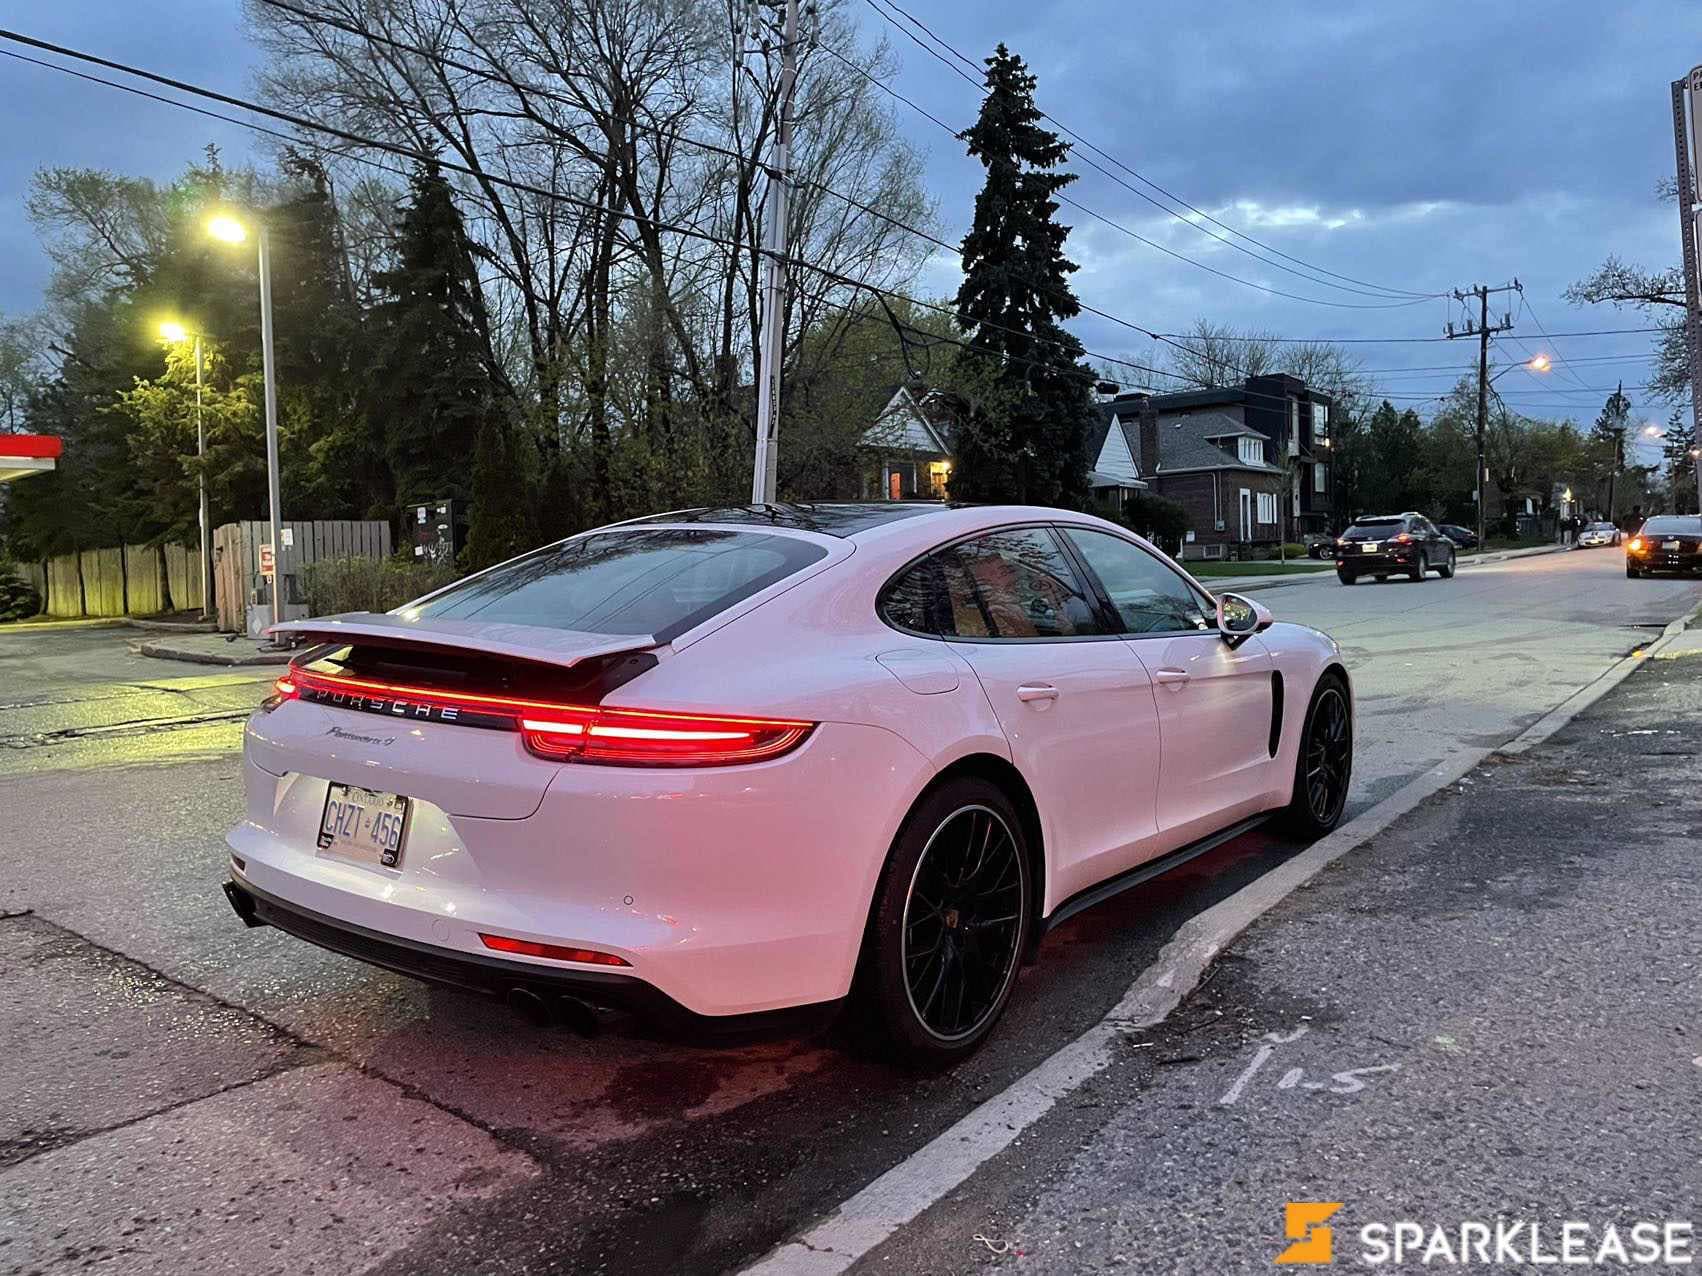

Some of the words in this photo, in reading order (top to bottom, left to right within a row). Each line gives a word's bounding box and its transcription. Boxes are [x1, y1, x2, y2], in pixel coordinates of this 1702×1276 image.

[316, 688, 459, 720] PORSCHE
[325, 800, 364, 839] CHZT
[371, 812, 401, 848] 456
